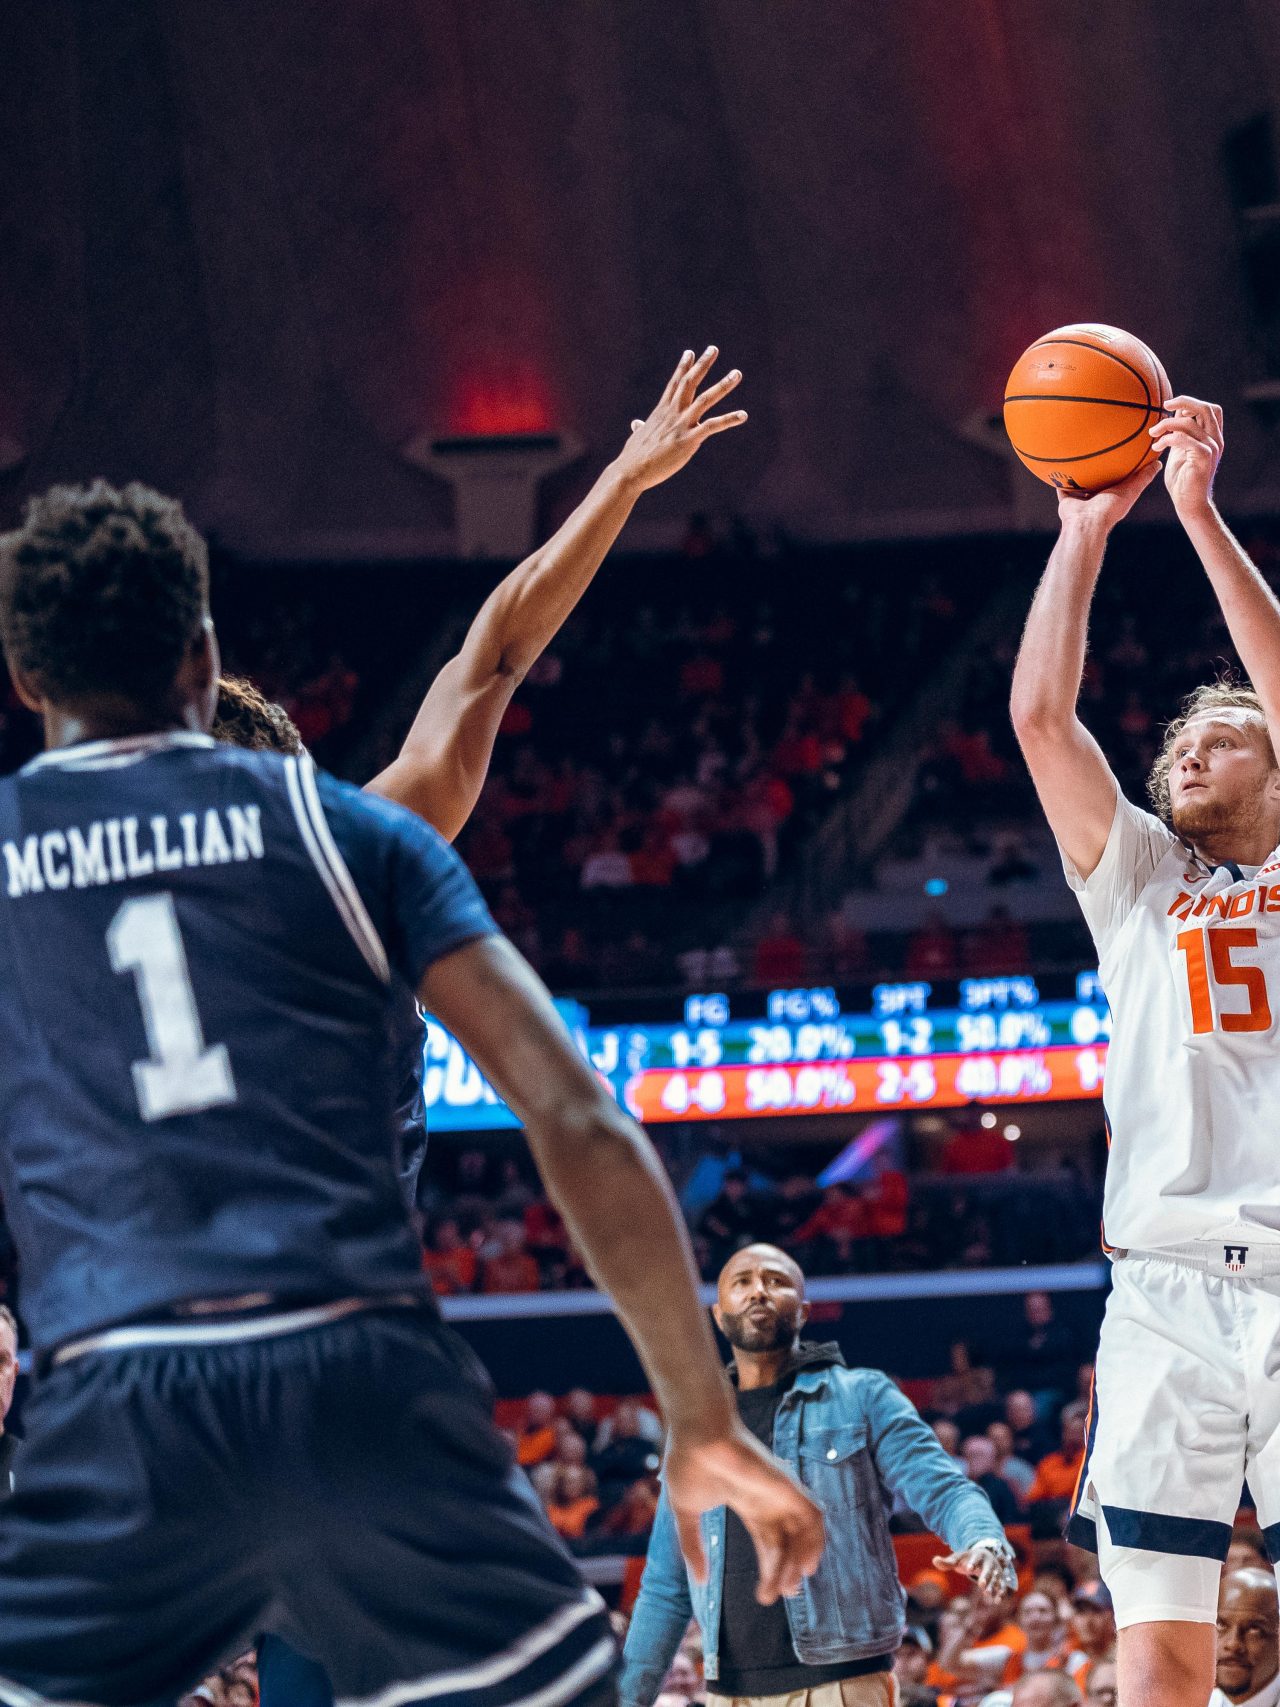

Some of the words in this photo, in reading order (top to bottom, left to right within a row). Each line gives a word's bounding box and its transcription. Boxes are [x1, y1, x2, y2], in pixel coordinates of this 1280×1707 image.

[3, 803, 265, 898] MCMILLIAN
[103, 890, 239, 1123] 1
[685, 993, 730, 1028] FG
[767, 987, 840, 1024] FG%
[1176, 927, 1273, 1034] 15
[671, 1029, 723, 1068] 1-5
[881, 1018, 934, 1057] 1-2
